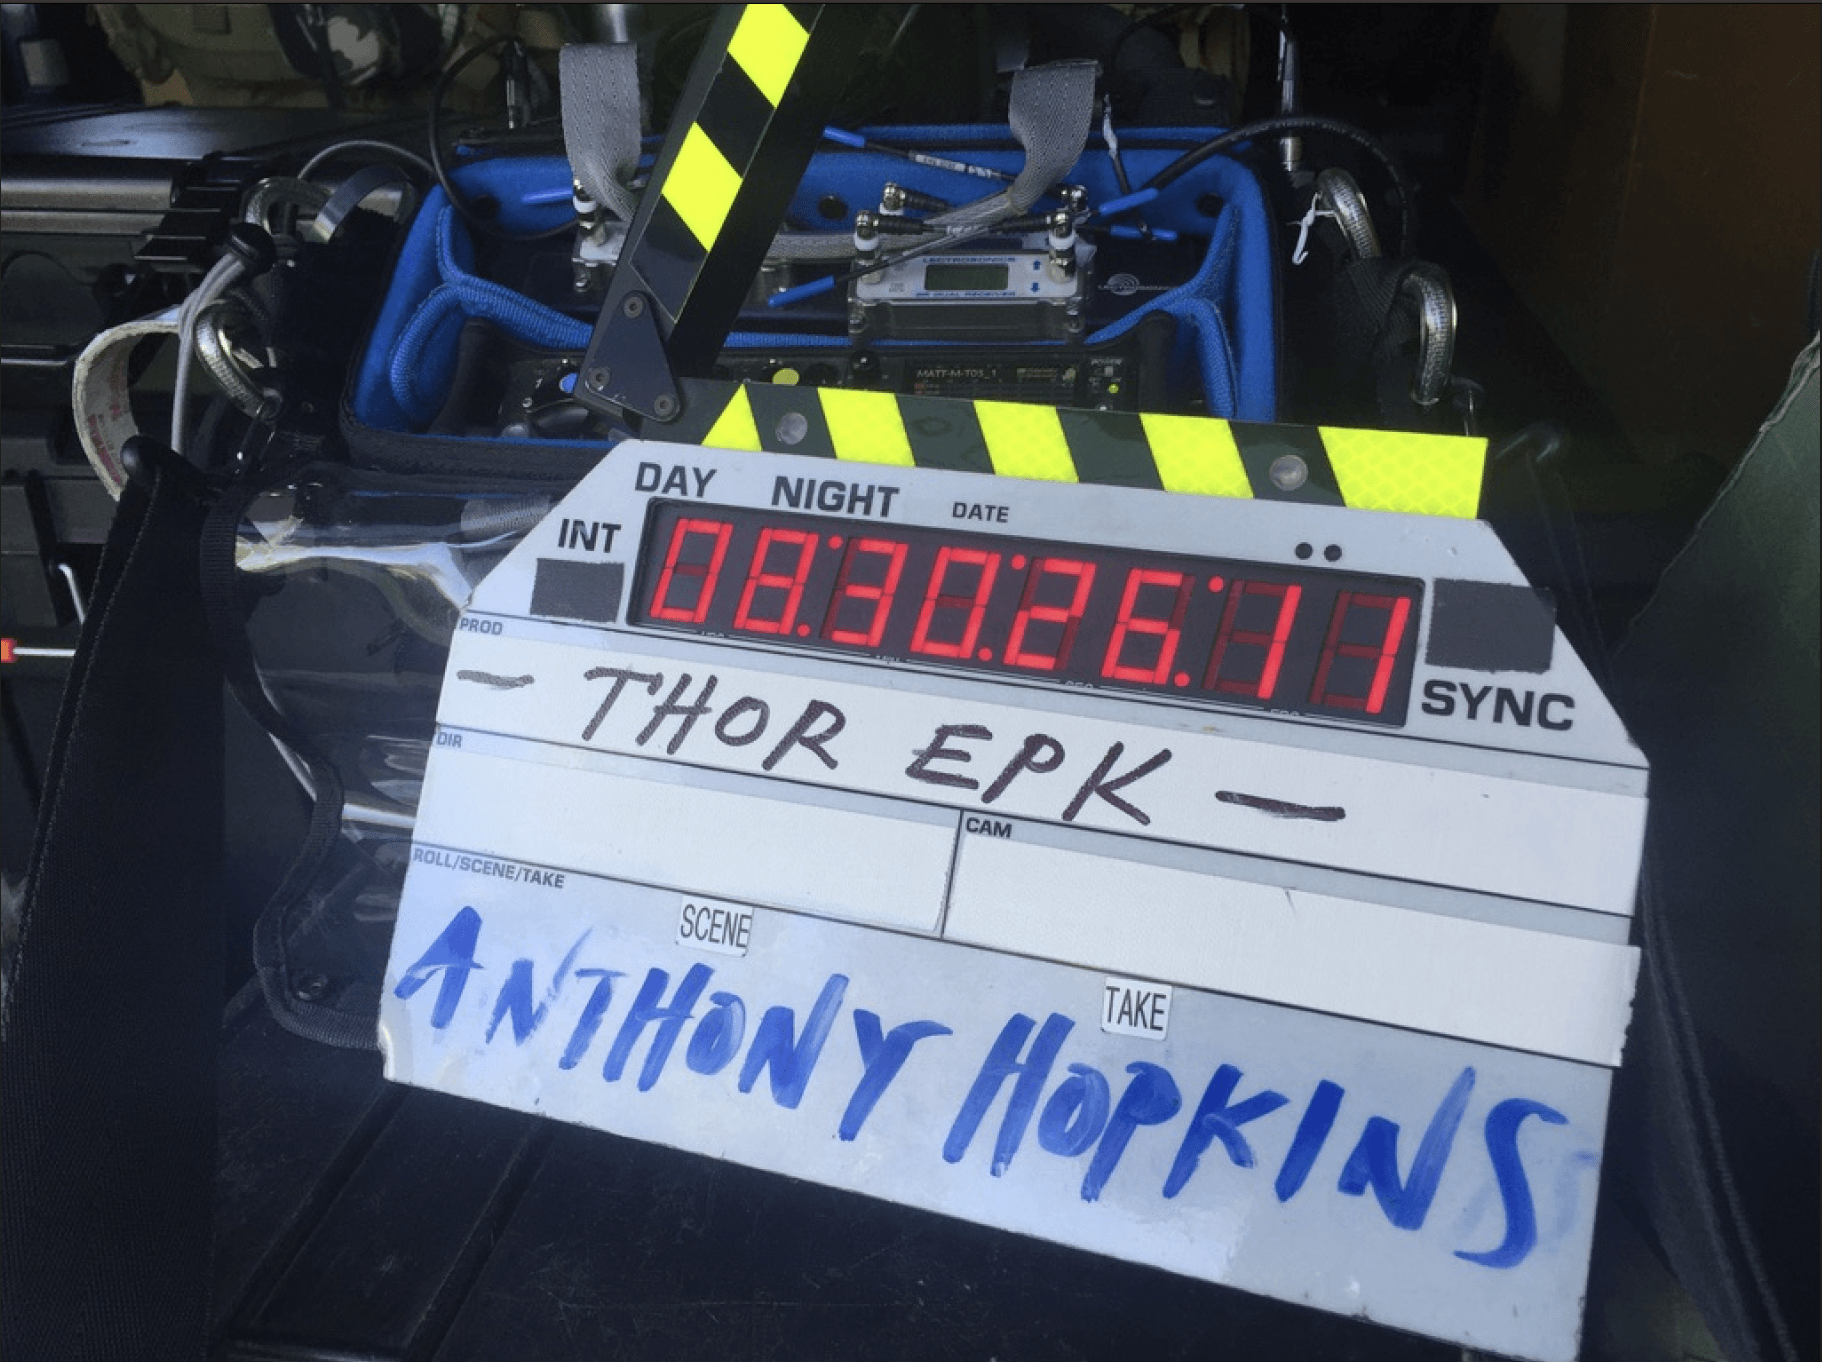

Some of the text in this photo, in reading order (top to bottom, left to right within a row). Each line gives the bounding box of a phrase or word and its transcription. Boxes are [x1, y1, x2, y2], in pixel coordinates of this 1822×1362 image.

[635, 461, 717, 499] DAY
[771, 476, 900, 519] NIGHT
[951, 502, 1009, 524] DATE
[557, 518, 622, 554] INT
[458, 616, 504, 637] PROD
[1421, 679, 1576, 732] SYNC
[436, 731, 463, 750] DIR
[583, 666, 847, 771] THOR
[905, 724, 1173, 826] EPK
[966, 816, 1012, 839] CAM
[413, 847, 565, 890] ROLL/SCENE/TAKE
[680, 905, 752, 949] SCENE
[1105, 985, 1165, 1032] TAKE
[394, 905, 1569, 1269] ANTHONY HOPKINS
